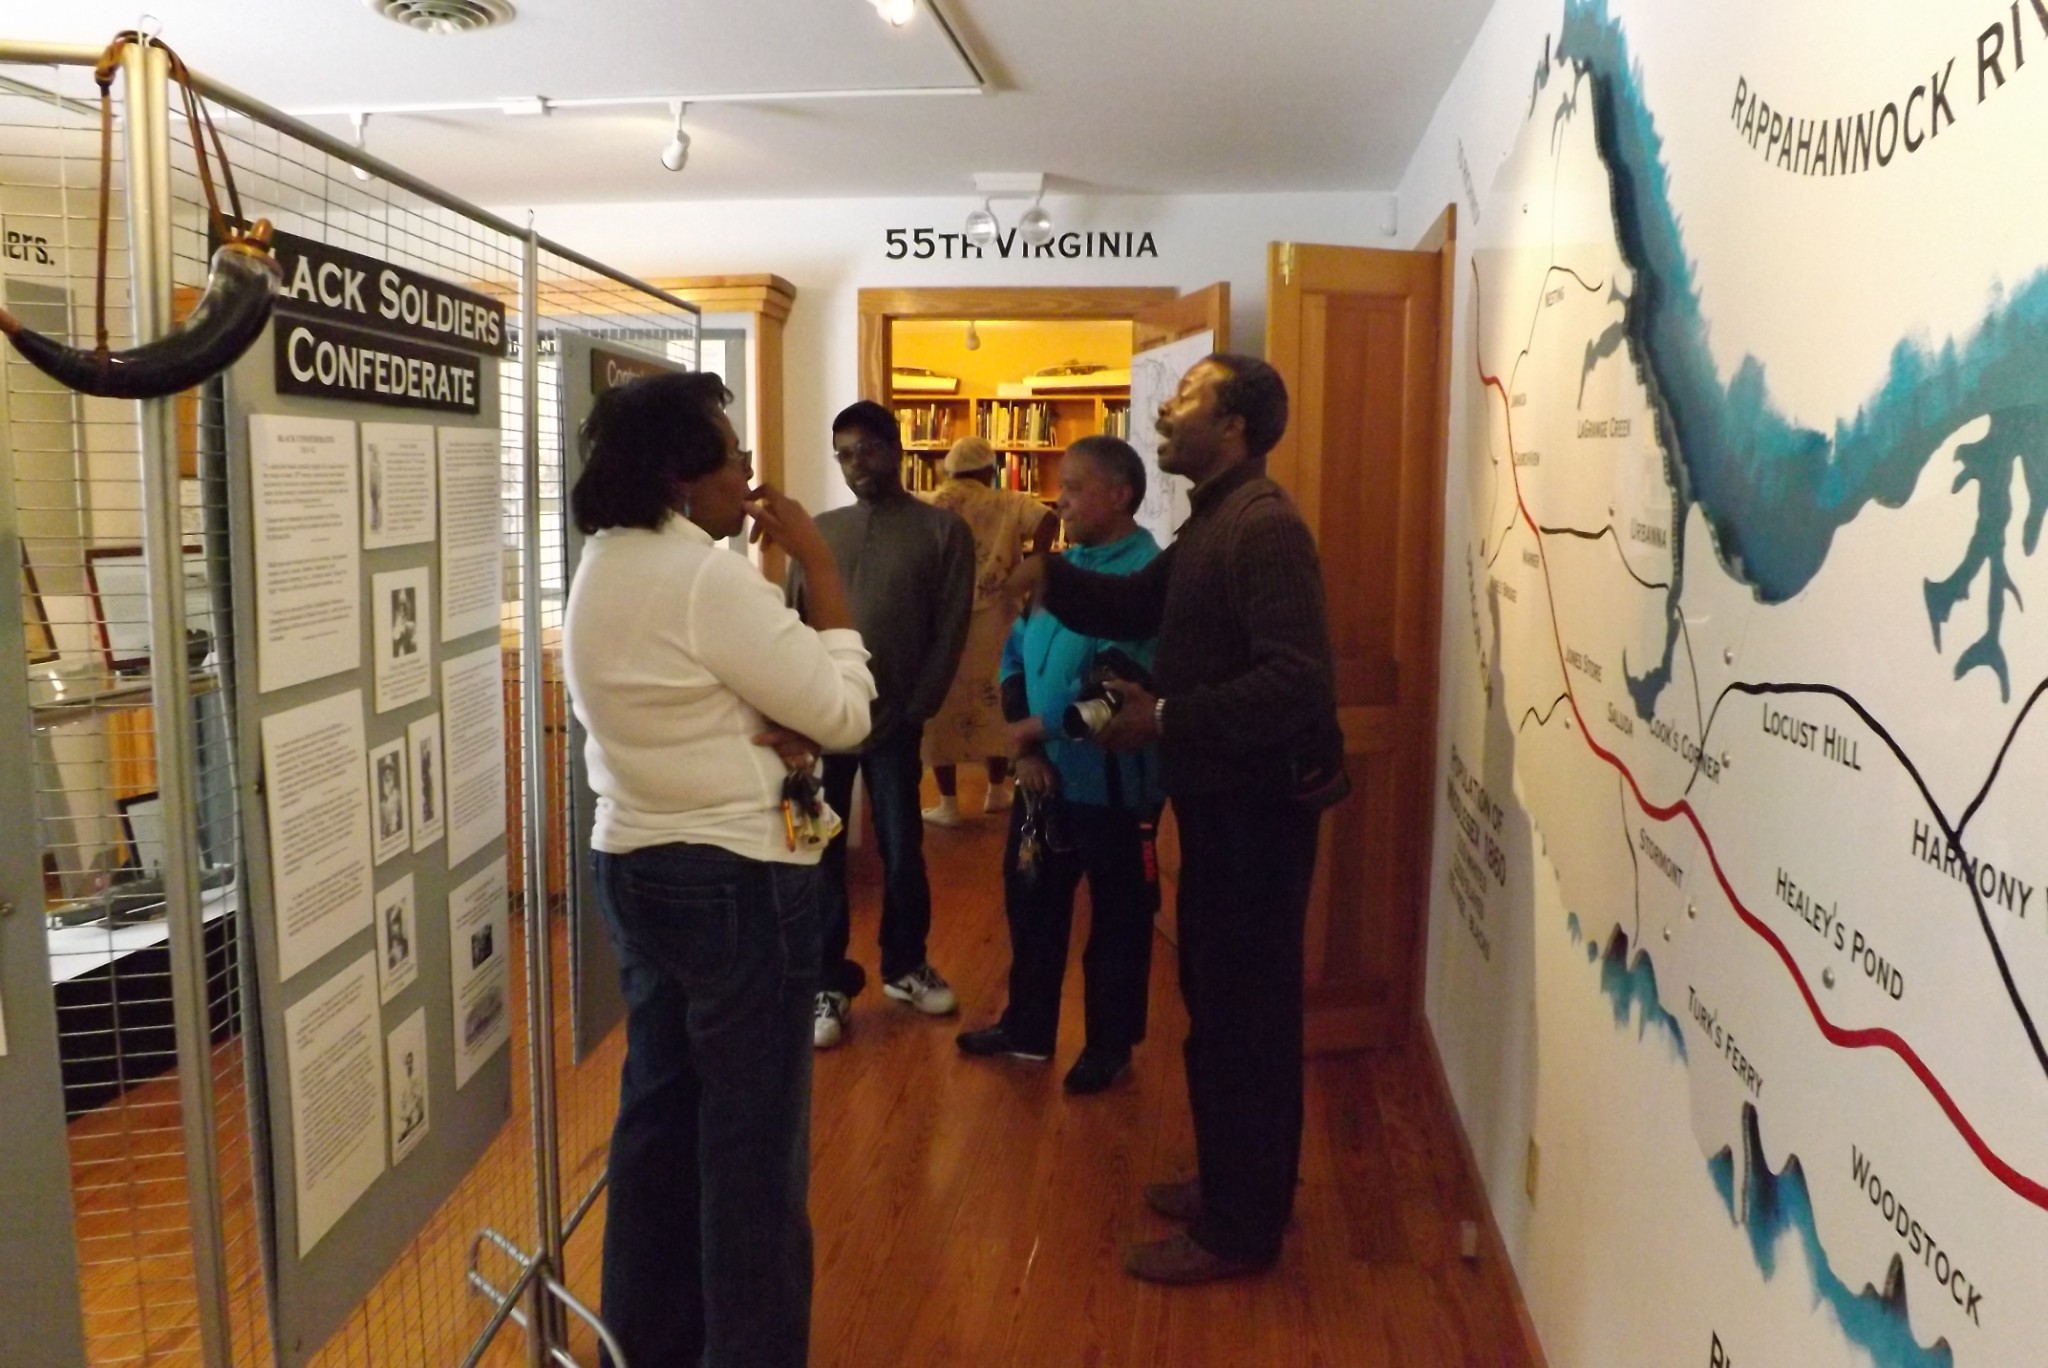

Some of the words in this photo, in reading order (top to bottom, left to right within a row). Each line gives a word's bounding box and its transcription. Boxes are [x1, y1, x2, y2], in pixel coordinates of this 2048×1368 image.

[1731, 56, 1956, 177] RAPPAHANNOCK
[885, 228, 983, 260] 55TH
[379, 269, 500, 346] SOLDIERS
[288, 326, 476, 406] CONFEDERATE
[1630, 517, 1667, 550] URBANNA
[1607, 702, 1633, 737] SALUDA
[1763, 702, 1818, 752] LOCUST
[1823, 724, 1862, 771] HILL
[1681, 733, 1721, 784] CORNER
[1640, 828, 1683, 888] STORMONT
[1912, 818, 2034, 919] HARMONY
[1776, 866, 1846, 951] HEALEY'S
[1851, 929, 1904, 1001] POND
[1688, 985, 1723, 1050] TURK'S
[1724, 1034, 1763, 1098] FERRY
[1851, 1144, 1983, 1328] WOODSTOCK
